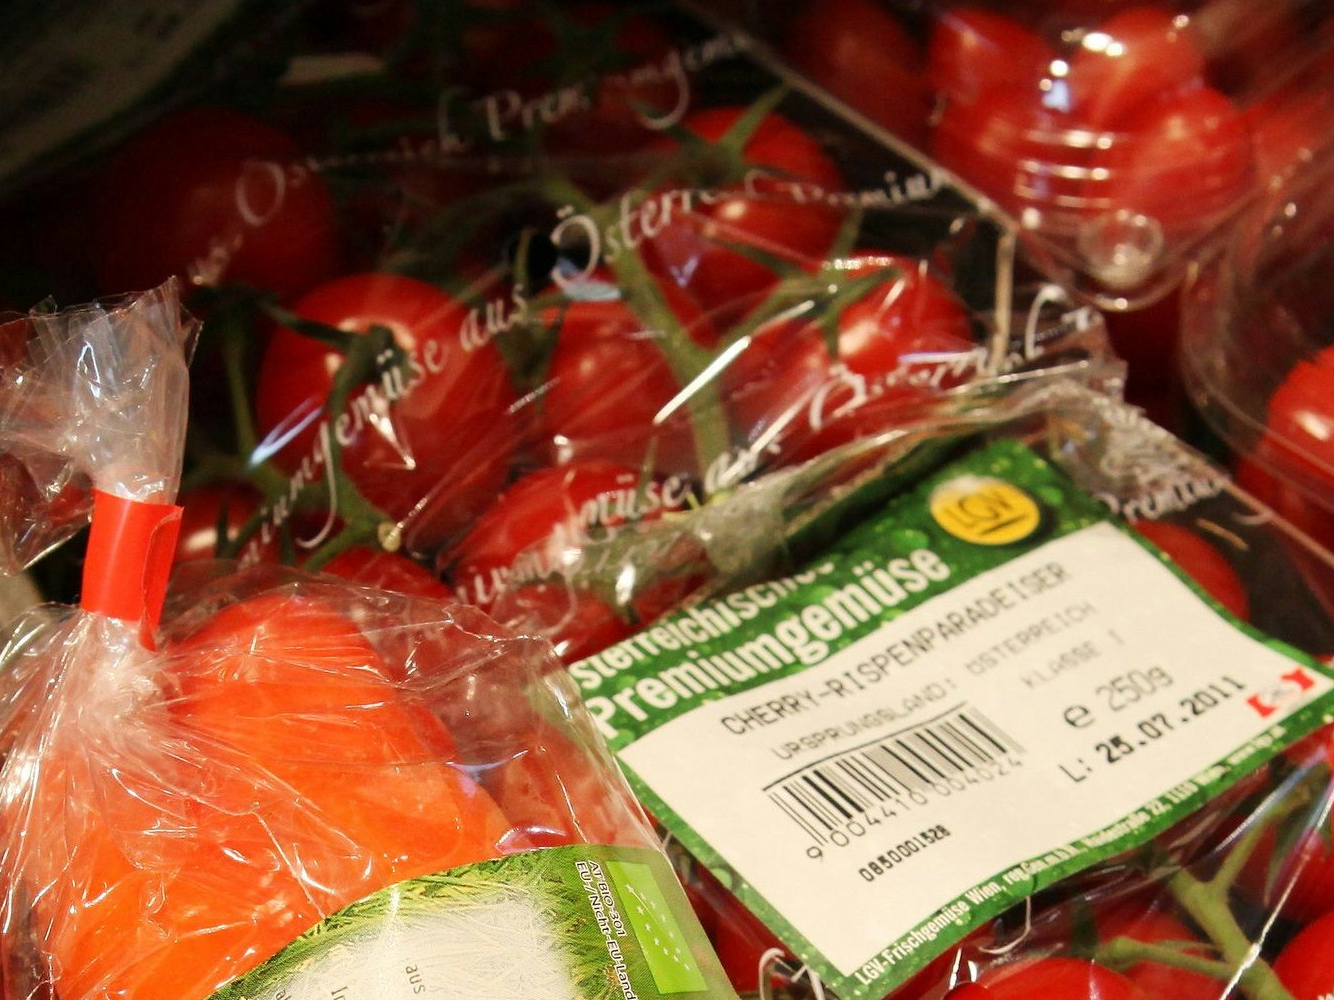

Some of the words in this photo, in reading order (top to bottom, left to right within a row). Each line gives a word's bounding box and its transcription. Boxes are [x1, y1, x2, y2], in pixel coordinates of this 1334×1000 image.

[585, 548, 952, 742] Premiumgemüse
[720, 561, 1072, 737] CHERRY-RISPENPARADEISER
[1021, 638, 1103, 690] KLASSE
[1095, 665, 1175, 713] 250g
[1058, 757, 1093, 784] L:
[1094, 675, 1247, 765] 25.07.2011
[805, 844, 825, 864] 9
[829, 790, 930, 850] 004410
[935, 756, 1025, 799] 004024
[857, 823, 952, 883] 0850001528
[405, 964, 426, 996] aus
[853, 899, 971, 986] LGV-Frischgemüse
[967, 879, 1008, 907] Wien,
